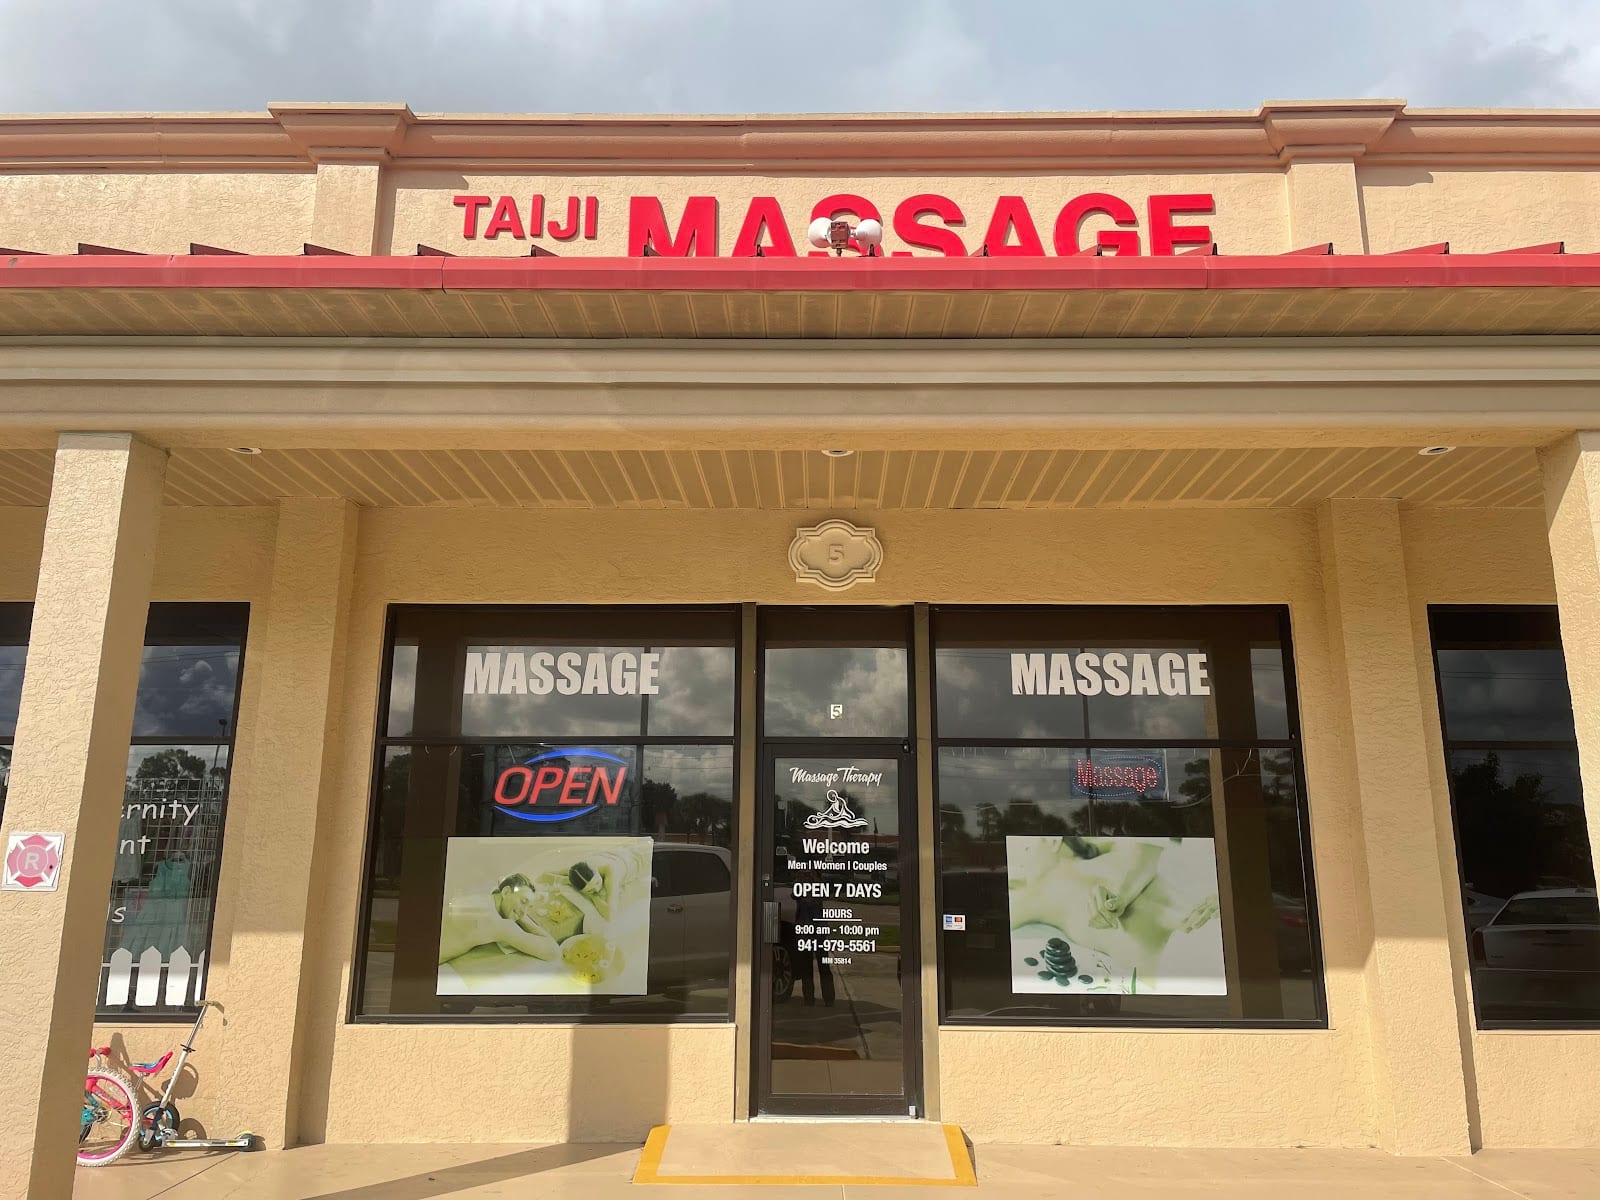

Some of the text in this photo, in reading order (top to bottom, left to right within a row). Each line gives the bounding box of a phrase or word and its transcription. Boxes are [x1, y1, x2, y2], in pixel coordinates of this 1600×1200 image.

[454, 195, 599, 239] TAIJI
[828, 543, 845, 565] 5
[463, 652, 660, 696] MASSAGE
[1010, 652, 1211, 697] MASSAGE
[831, 704, 843, 720] 5
[789, 765, 882, 787] Massage Therapy
[1077, 759, 1158, 793] Massage
[494, 766, 627, 805] OPEN
[121, 798, 200, 826] rnity
[802, 838, 870, 854] Welcome
[24, 852, 40, 870] R
[787, 860, 806, 870] Men
[813, 861, 845, 870] Women
[852, 860, 887, 872] Couples
[793, 882, 882, 898] OPEN 7 DAYS
[822, 908, 853, 919] HOURS
[795, 924, 815, 935] 9:00
[816, 926, 831, 935] am
[839, 925, 863, 935] 10:00
[865, 927, 880, 937] pm
[797, 938, 876, 952] 941-979-5561
[821, 956, 852, 965] MM 35814
